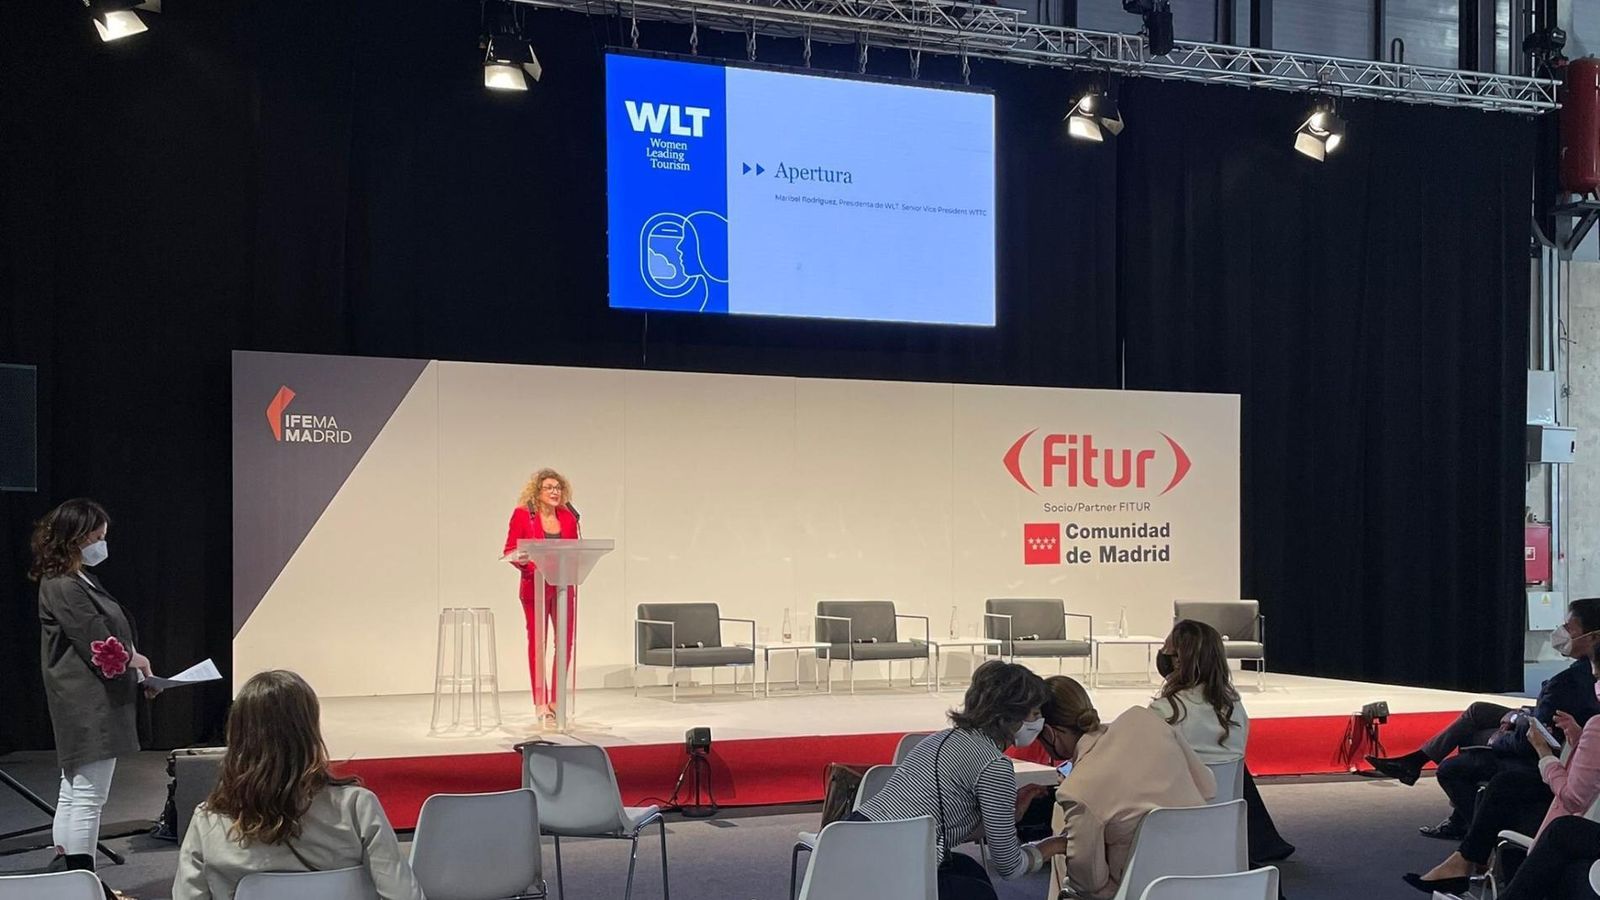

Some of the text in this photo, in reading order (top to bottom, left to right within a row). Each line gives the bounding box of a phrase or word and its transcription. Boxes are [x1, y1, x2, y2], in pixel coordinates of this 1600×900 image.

[625, 100, 710, 137] WLT
[650, 138, 687, 150] Women
[646, 148, 685, 161] Leading
[650, 159, 690, 171] Tourism
[774, 161, 853, 184] Apertura
[775, 194, 800, 202] Maribel
[874, 201, 884, 209] de
[902, 204, 922, 212] Senior
[285, 414, 338, 429] IFEMA
[285, 429, 353, 443] MADRID
[1043, 434, 1156, 488] Fitur
[1043, 502, 1151, 513] Socio/Partner FITUR
[1065, 522, 1171, 540] Comunidad
[1066, 545, 1170, 564] de Madrid
